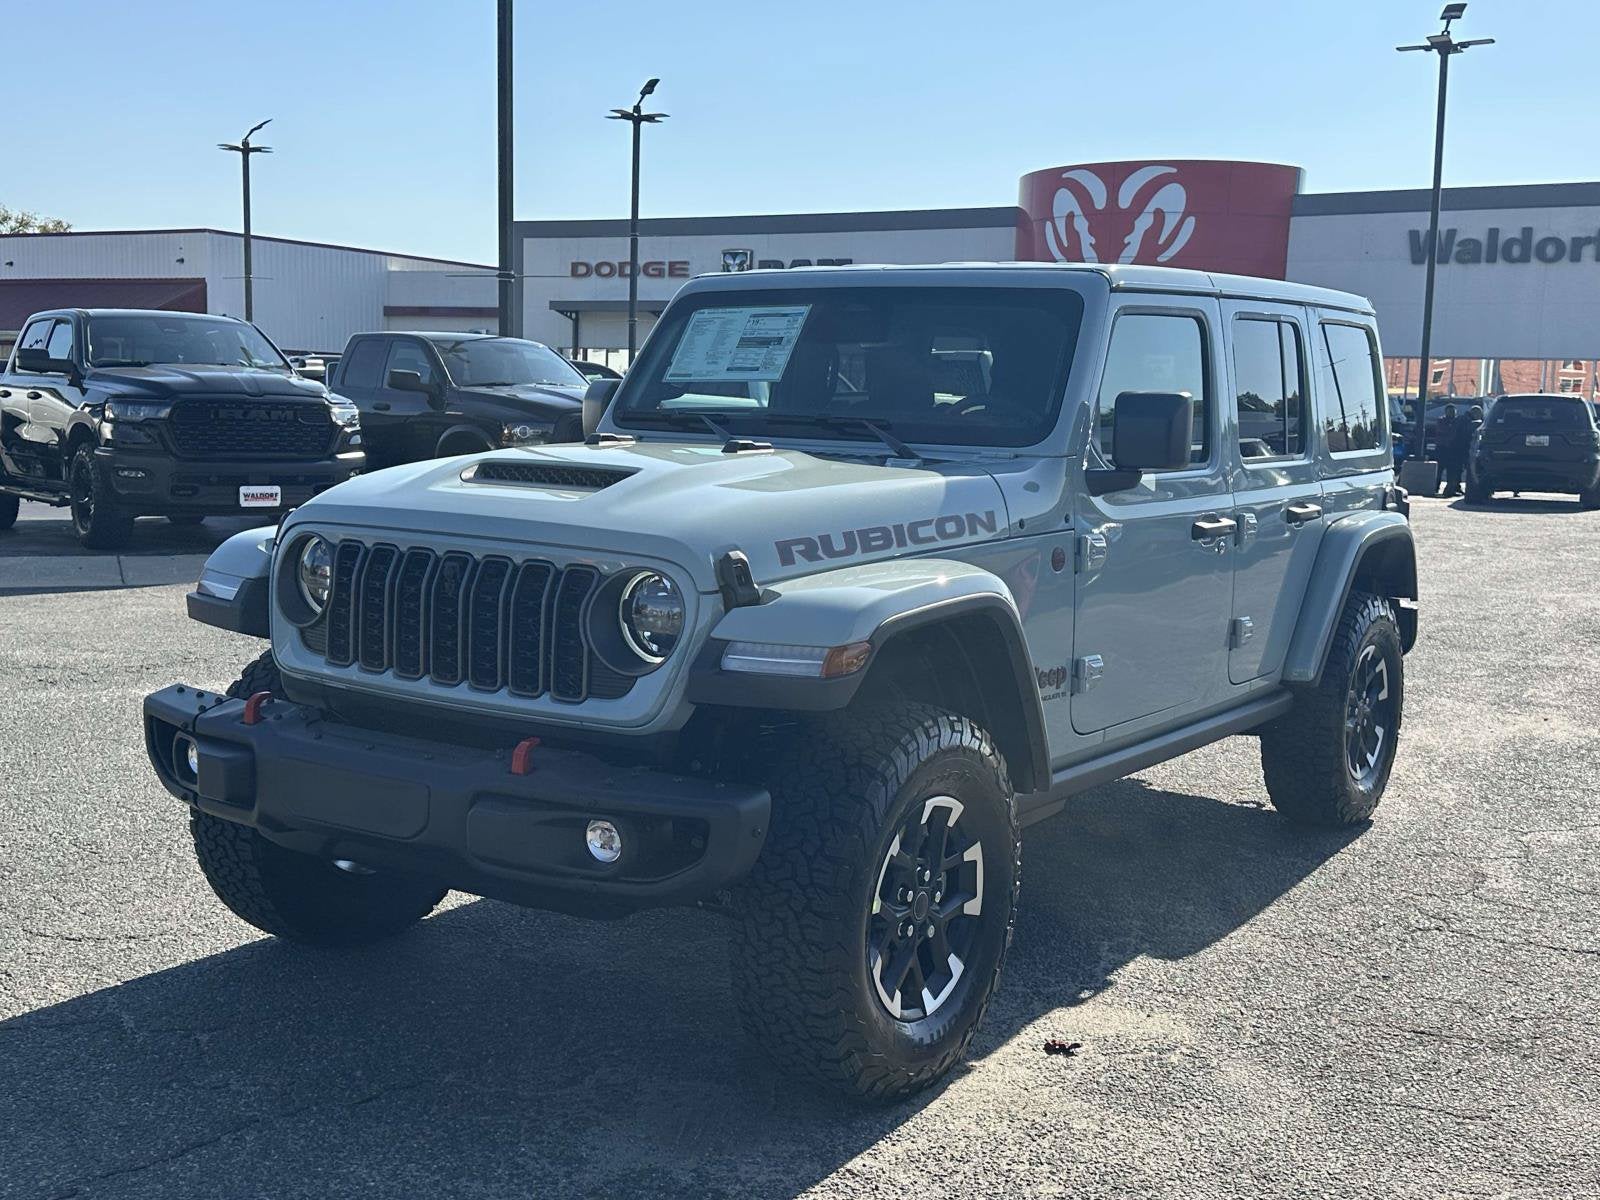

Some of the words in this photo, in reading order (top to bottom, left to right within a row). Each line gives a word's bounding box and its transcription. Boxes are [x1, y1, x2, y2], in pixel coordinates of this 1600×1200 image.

[570, 261, 690, 278] DODGE
[218, 409, 294, 421] RAM
[774, 510, 997, 567] RUBICON
